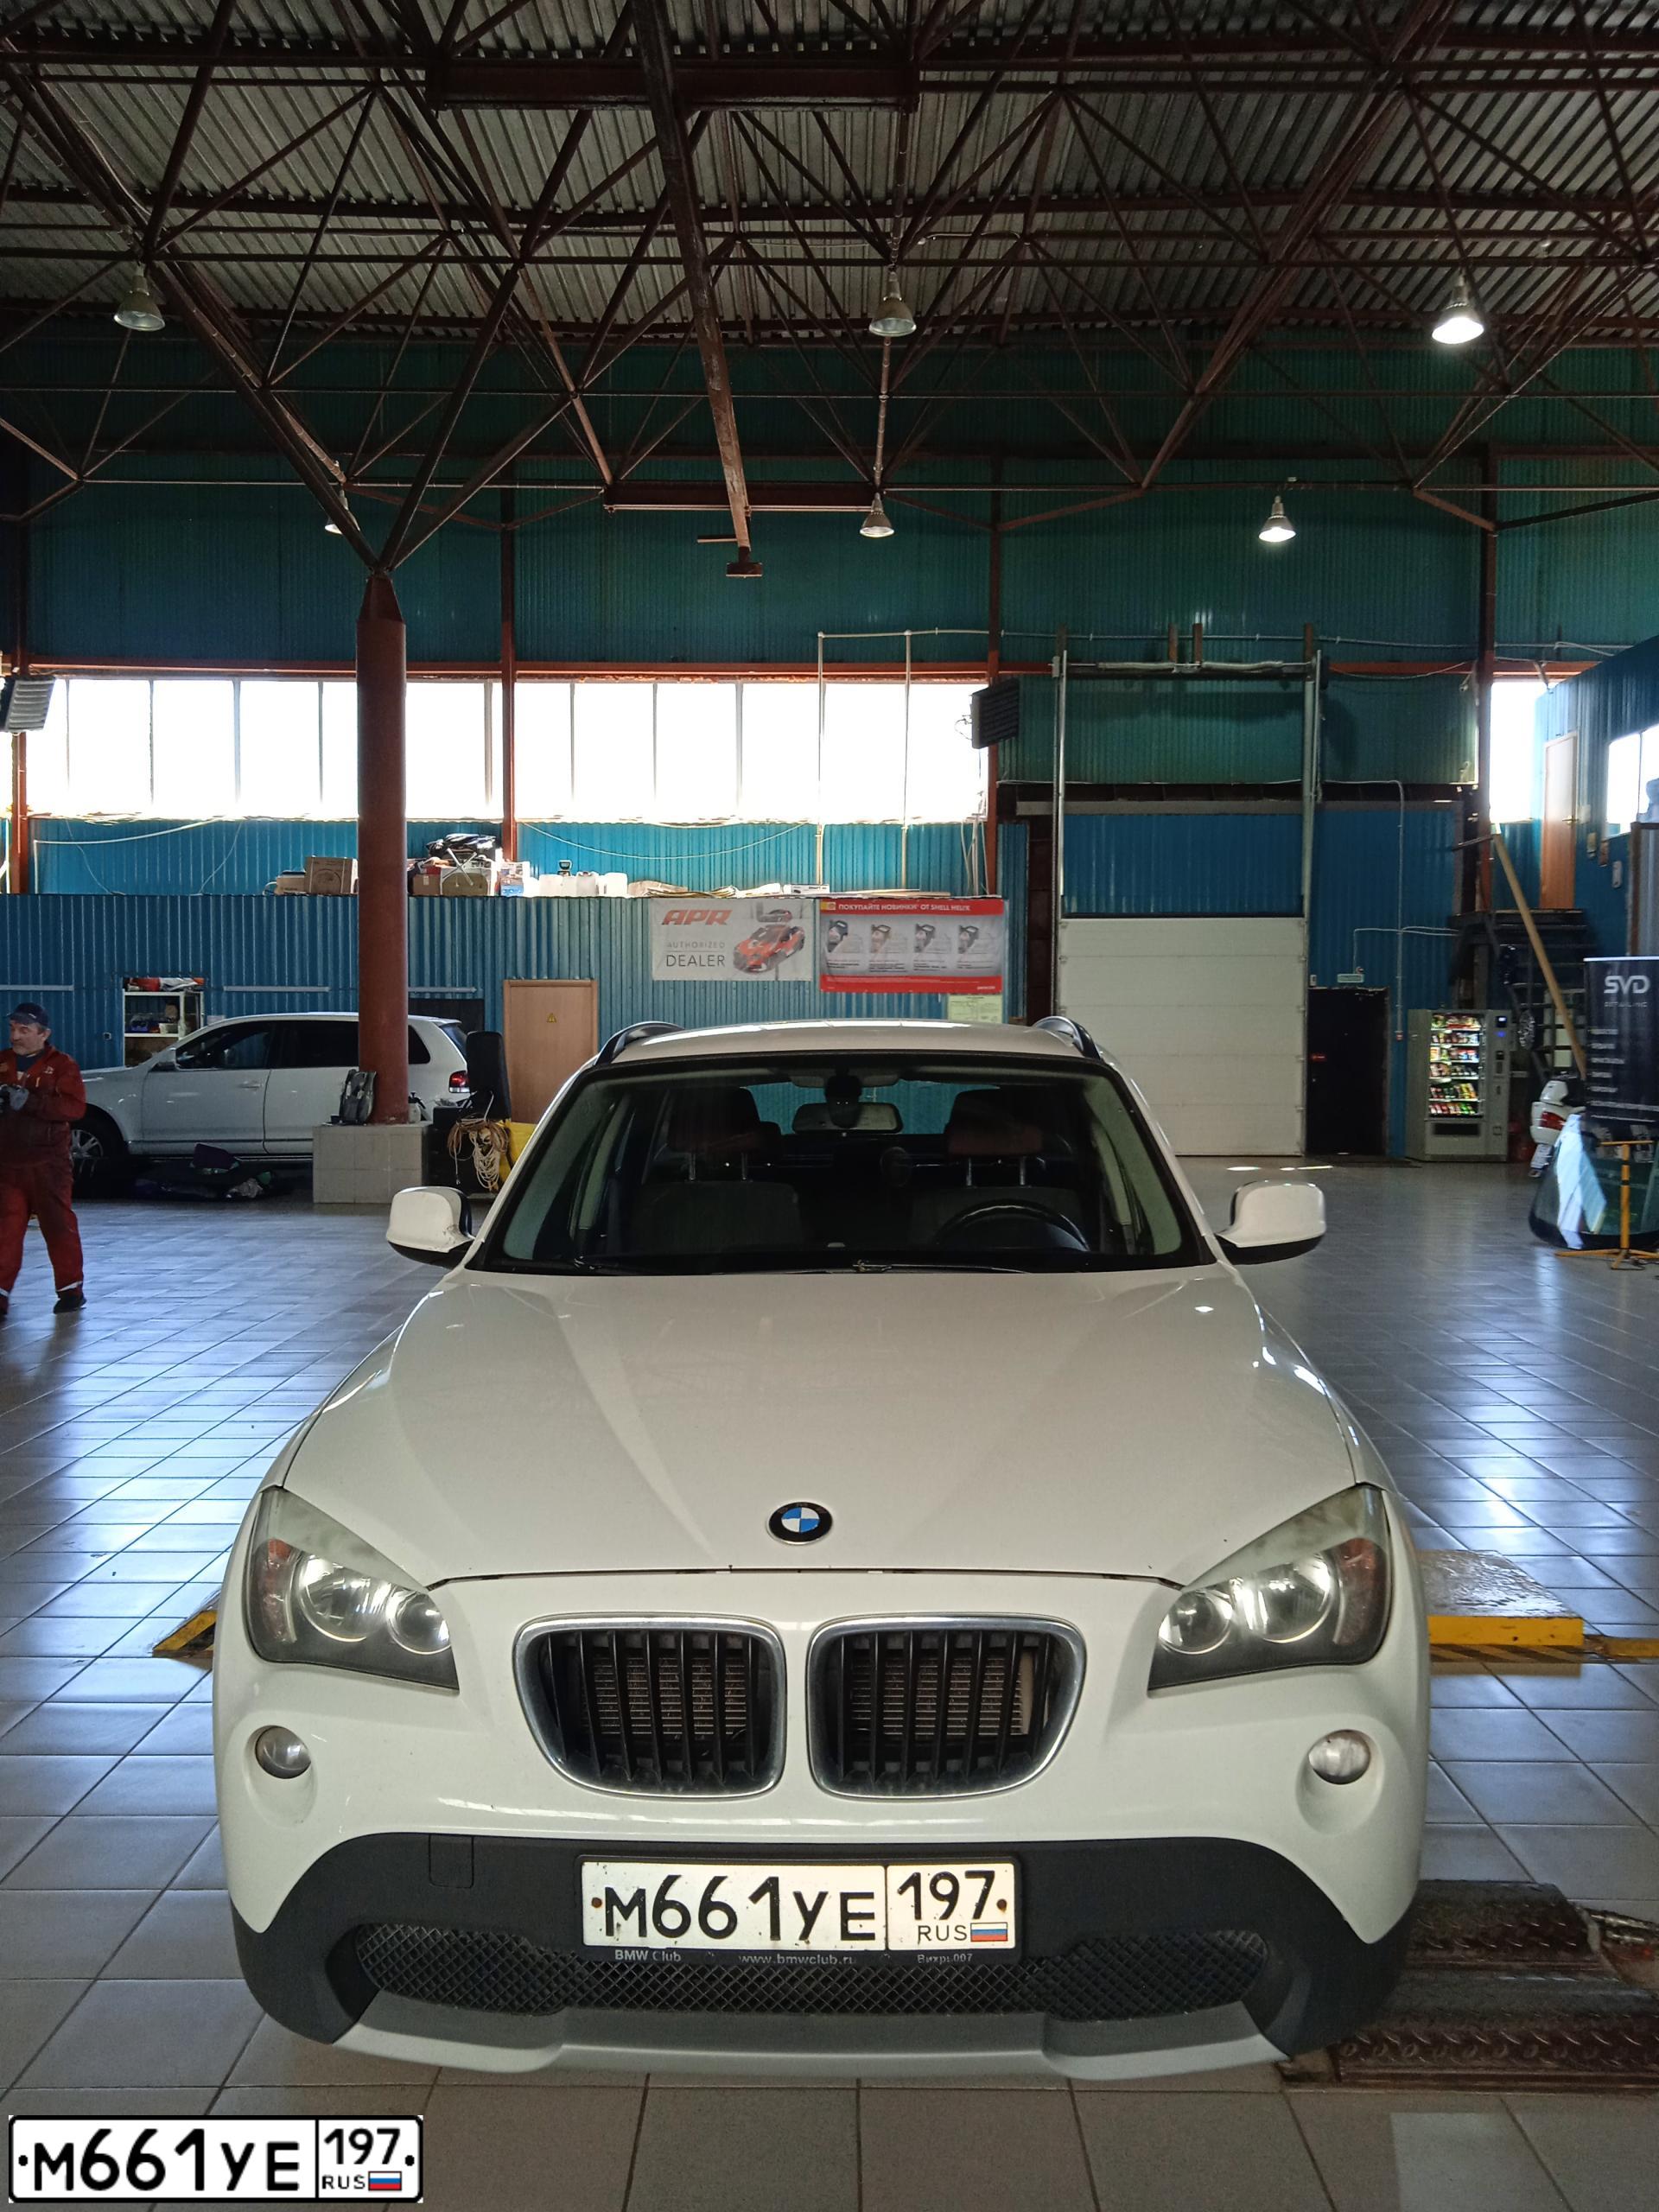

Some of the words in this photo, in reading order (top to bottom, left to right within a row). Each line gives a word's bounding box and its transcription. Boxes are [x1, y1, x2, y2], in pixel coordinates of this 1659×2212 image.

[661, 909, 733, 925] APR
[665, 954, 726, 967] DEALER
[897, 1870, 996, 1921] 197
[918, 1924, 968, 1942] RUS
[614, 1949, 649, 1961] BMW
[652, 1951, 682, 1962] Club
[738, 1953, 857, 1966] www.bmwclub.ru
